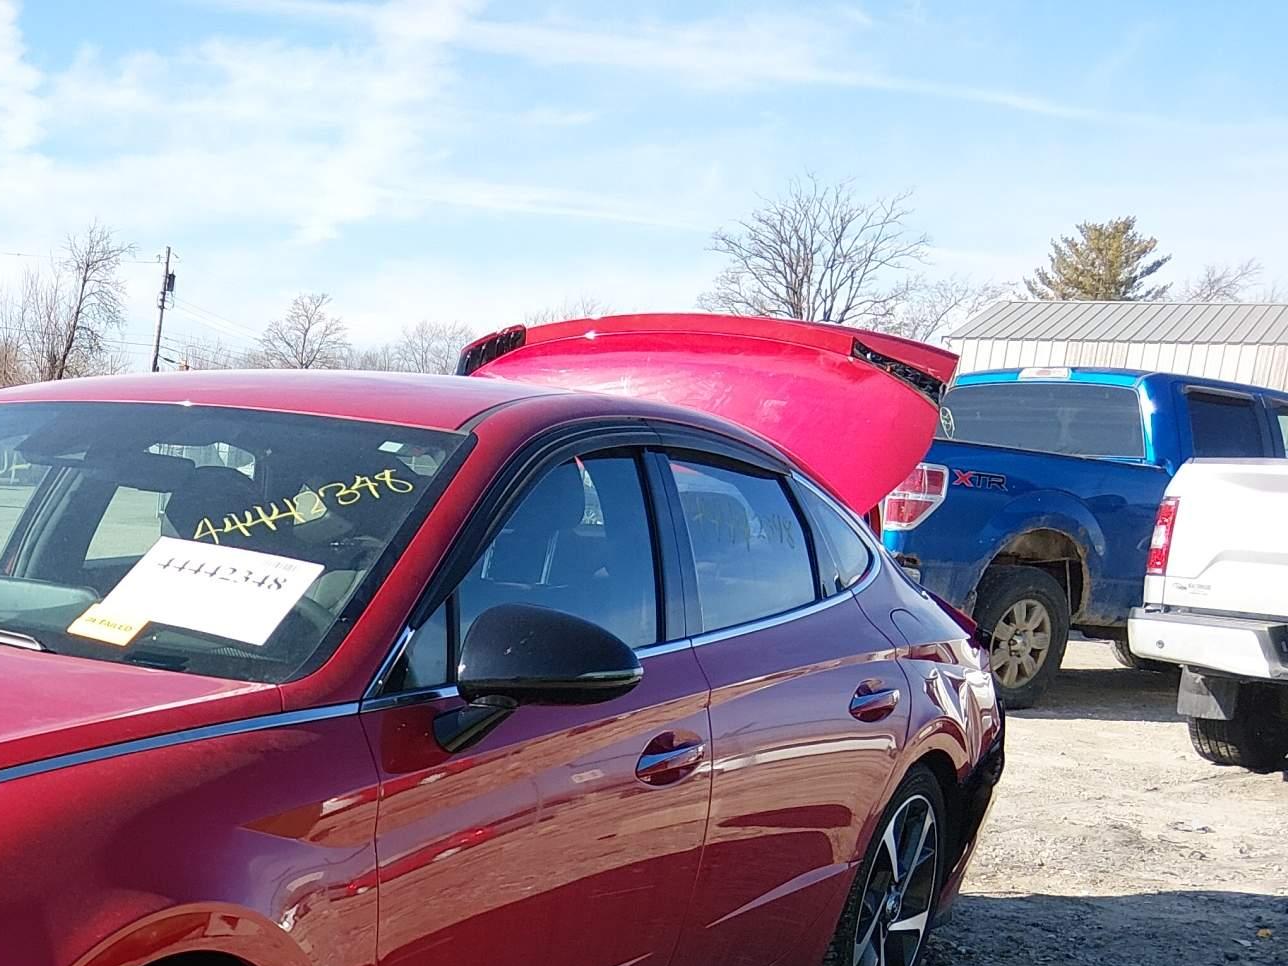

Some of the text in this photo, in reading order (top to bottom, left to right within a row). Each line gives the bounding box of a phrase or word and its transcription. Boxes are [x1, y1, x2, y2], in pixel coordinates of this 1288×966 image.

[952, 468, 1009, 492] XTR
[193, 468, 414, 544] 44442348
[157, 557, 287, 592] 44442348
